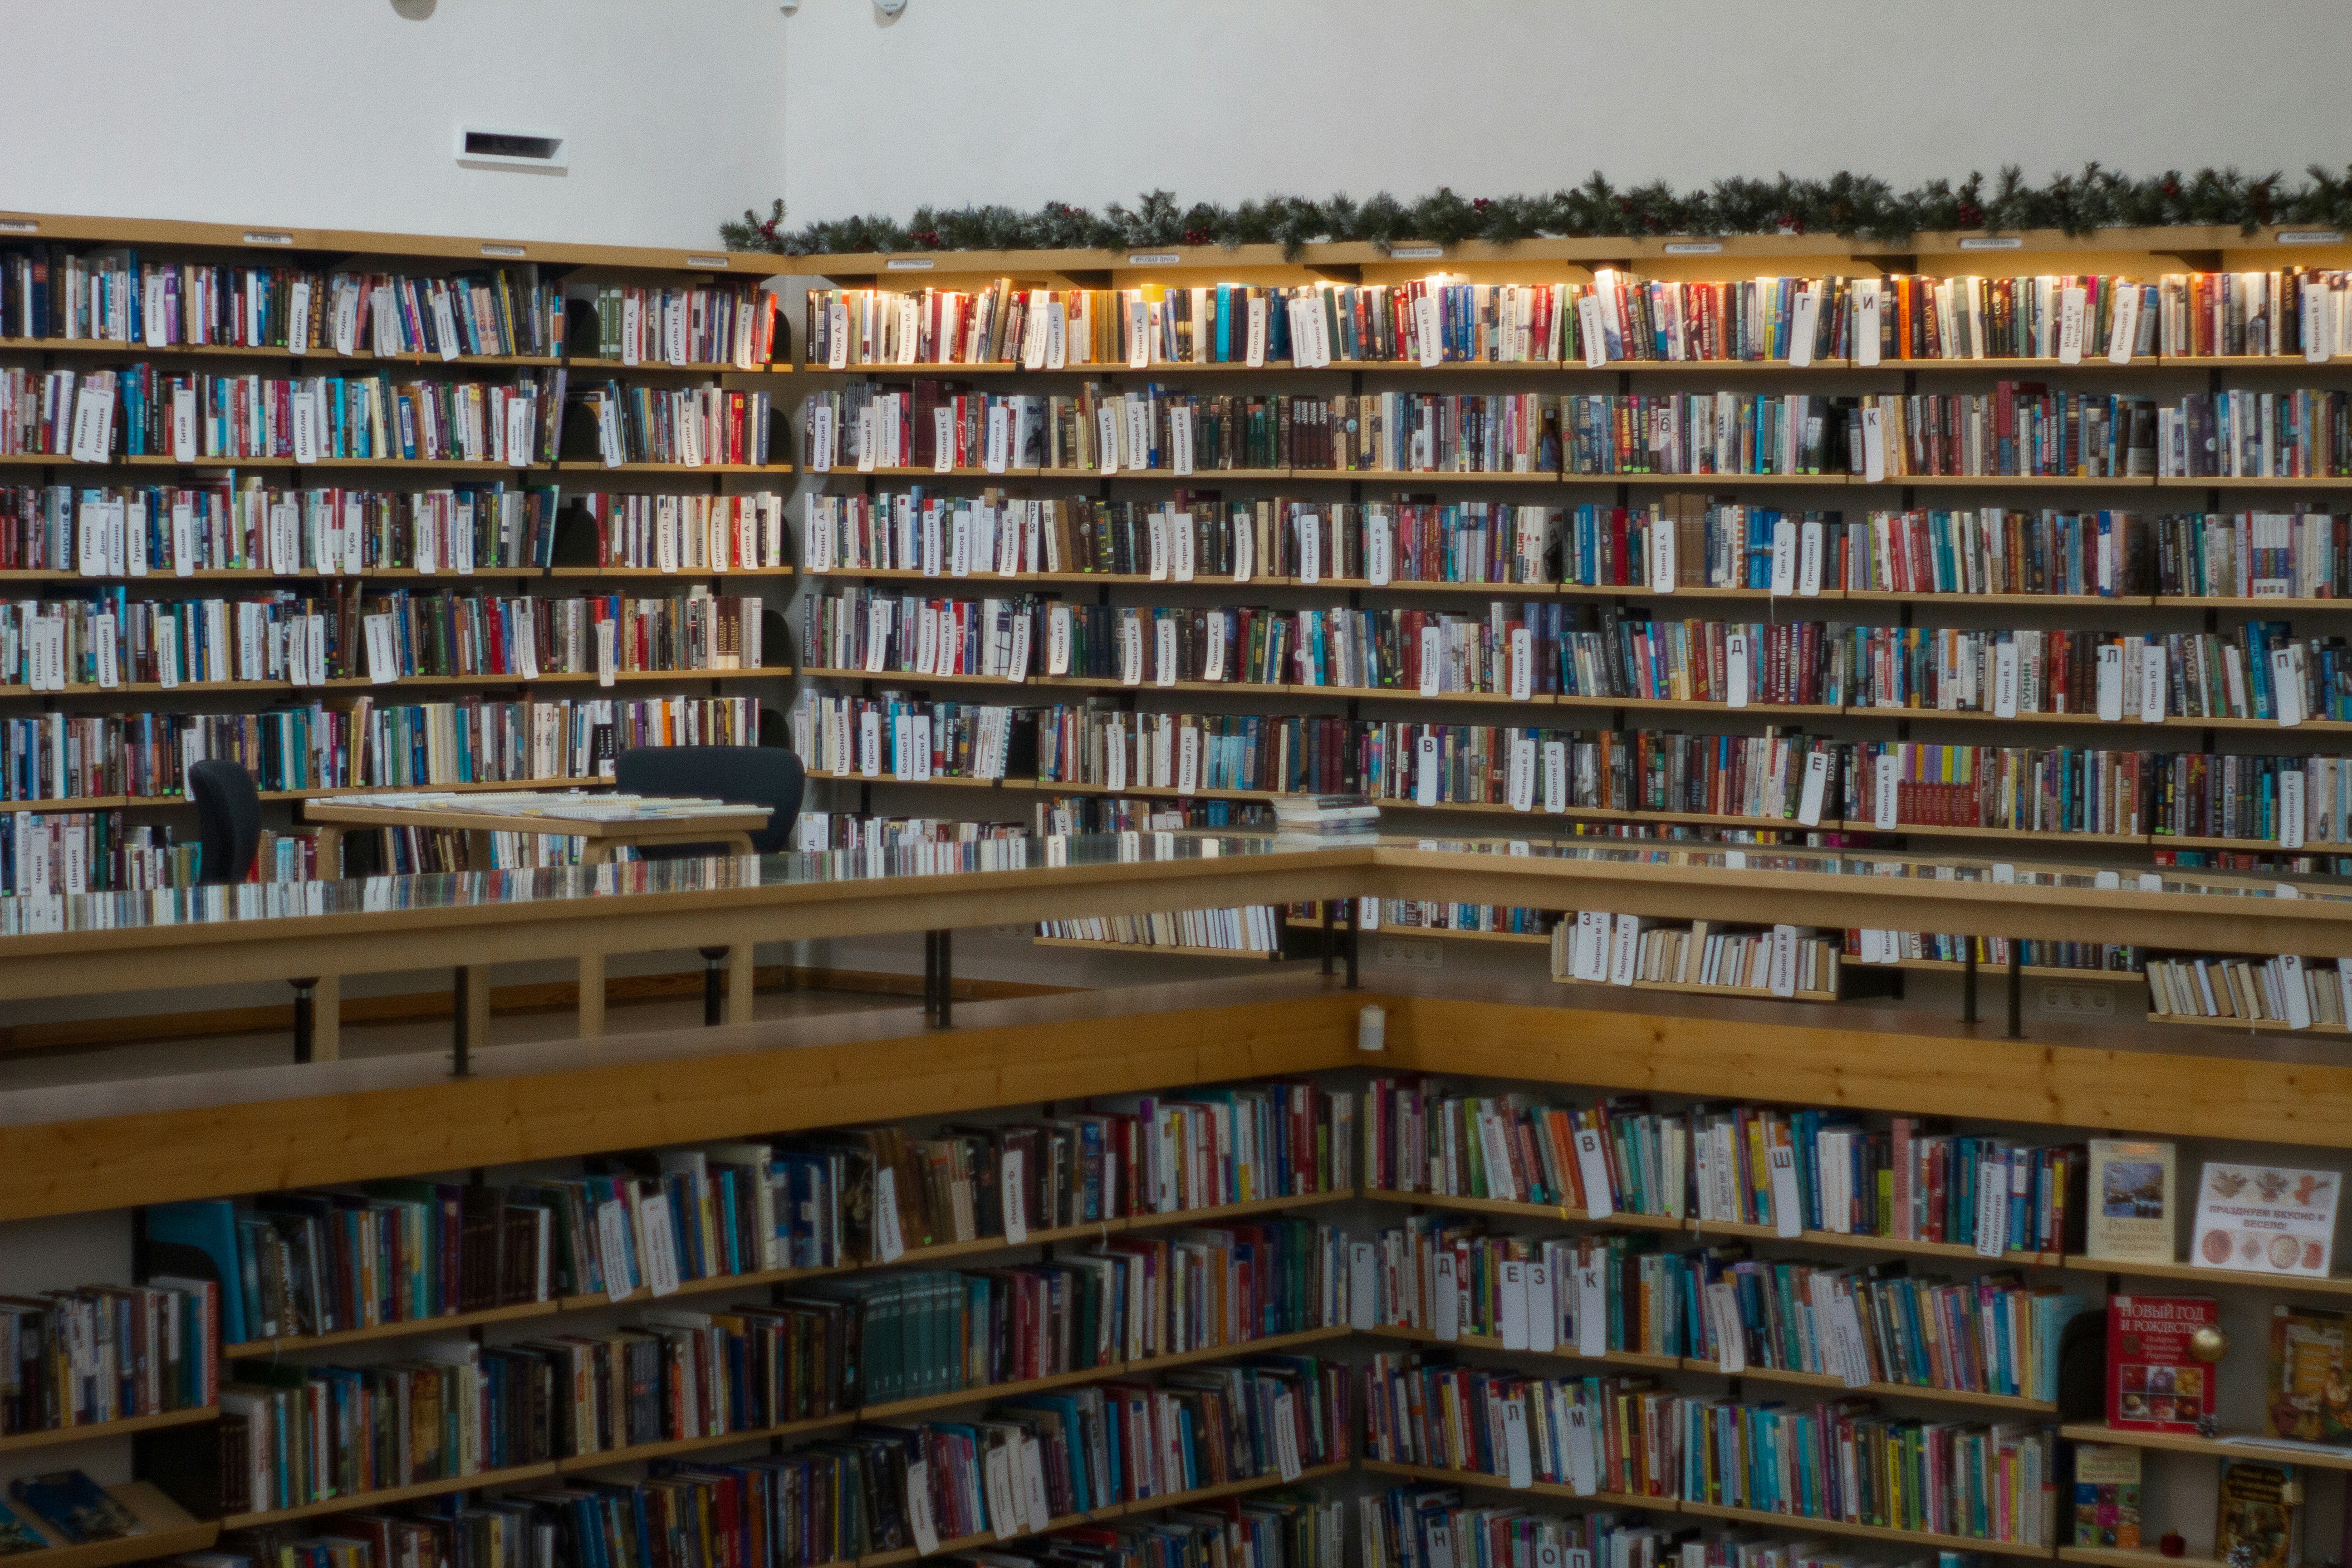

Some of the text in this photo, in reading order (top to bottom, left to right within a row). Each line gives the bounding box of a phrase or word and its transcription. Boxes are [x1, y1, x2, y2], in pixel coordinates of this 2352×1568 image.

[253, 234, 284, 243] ИСТОРИЯ
[1801, 298, 1810, 311] Г
[1863, 296, 1873, 309] И
[294, 308, 303, 348] Израиль
[1924, 305, 1935, 341] ТОБОЛ
[2117, 299, 2129, 351] Искандер Ф.
[833, 309, 842, 362] Блок А. А.
[865, 417, 871, 428] М.
[995, 416, 1000, 425] А.
[1641, 410, 1649, 440] ЖАЖДА
[1867, 412, 1876, 426] К
[78, 409, 88, 449] Венгрия
[94, 407, 105, 454] Германия
[605, 408, 614, 459] Лермонтов М.
[818, 413, 826, 468] Высоцкий В.
[1178, 428, 1186, 472] Достоевский
[818, 510, 825, 521] А.
[928, 512, 934, 520] В.
[819, 524, 826, 532] С.
[958, 524, 965, 533] В.
[1305, 521, 1312, 529] П.
[61, 518, 69, 564] БИСМАРК
[133, 529, 142, 563] Турция
[1005, 533, 1014, 571] Пастернак
[1806, 541, 1815, 586] Гришковец
[373, 626, 382, 671] Литературоведение
[1014, 621, 1024, 675] Шолохов М.
[1731, 639, 1743, 655] Д
[2107, 649, 2117, 663] Л
[2277, 653, 2288, 668] П
[2150, 671, 2156, 679] Ю.
[2023, 663, 2031, 709] КУНИН
[867, 727, 873, 737] М.
[901, 731, 907, 740] П.
[918, 730, 925, 740] А.
[837, 715, 846, 772] Персоналии
[1424, 740, 1433, 753] В
[1550, 757, 1558, 766] С.
[1812, 756, 1822, 771] Е
[1882, 763, 1890, 822] Леонтьев А. В.
[2287, 956, 2294, 970] Р
[1582, 1136, 1595, 1152] В
[1773, 1152, 1791, 1169] Ш
[1008, 1168, 1015, 1181] Ф.
[1980, 1171, 1991, 1253] Педагогическая
[2210, 1205, 2272, 1217] ПРАЗДНУЕМ
[2273, 1210, 2316, 1221] ВКУСНО
[1992, 1194, 2001, 1254] психология
[2243, 1219, 2288, 1230] ВЕСЕЛО!
[1356, 1247, 1367, 1263] Г
[1438, 1258, 1451, 1277] Д
[1507, 1266, 1519, 1282] Е
[1534, 1268, 1545, 1285] З
[1585, 1272, 1597, 1288] К
[2122, 1304, 2205, 1323] НОВЫЙ ГОД
[2121, 1321, 2129, 1331] И
[1508, 1404, 1519, 1421] Л
[1571, 1411, 1585, 1427] М
[916, 1498, 925, 1530] Логика
[1433, 1531, 1446, 1547] Н
[1542, 1548, 1556, 1564] О
[1573, 1553, 1585, 1568] П
